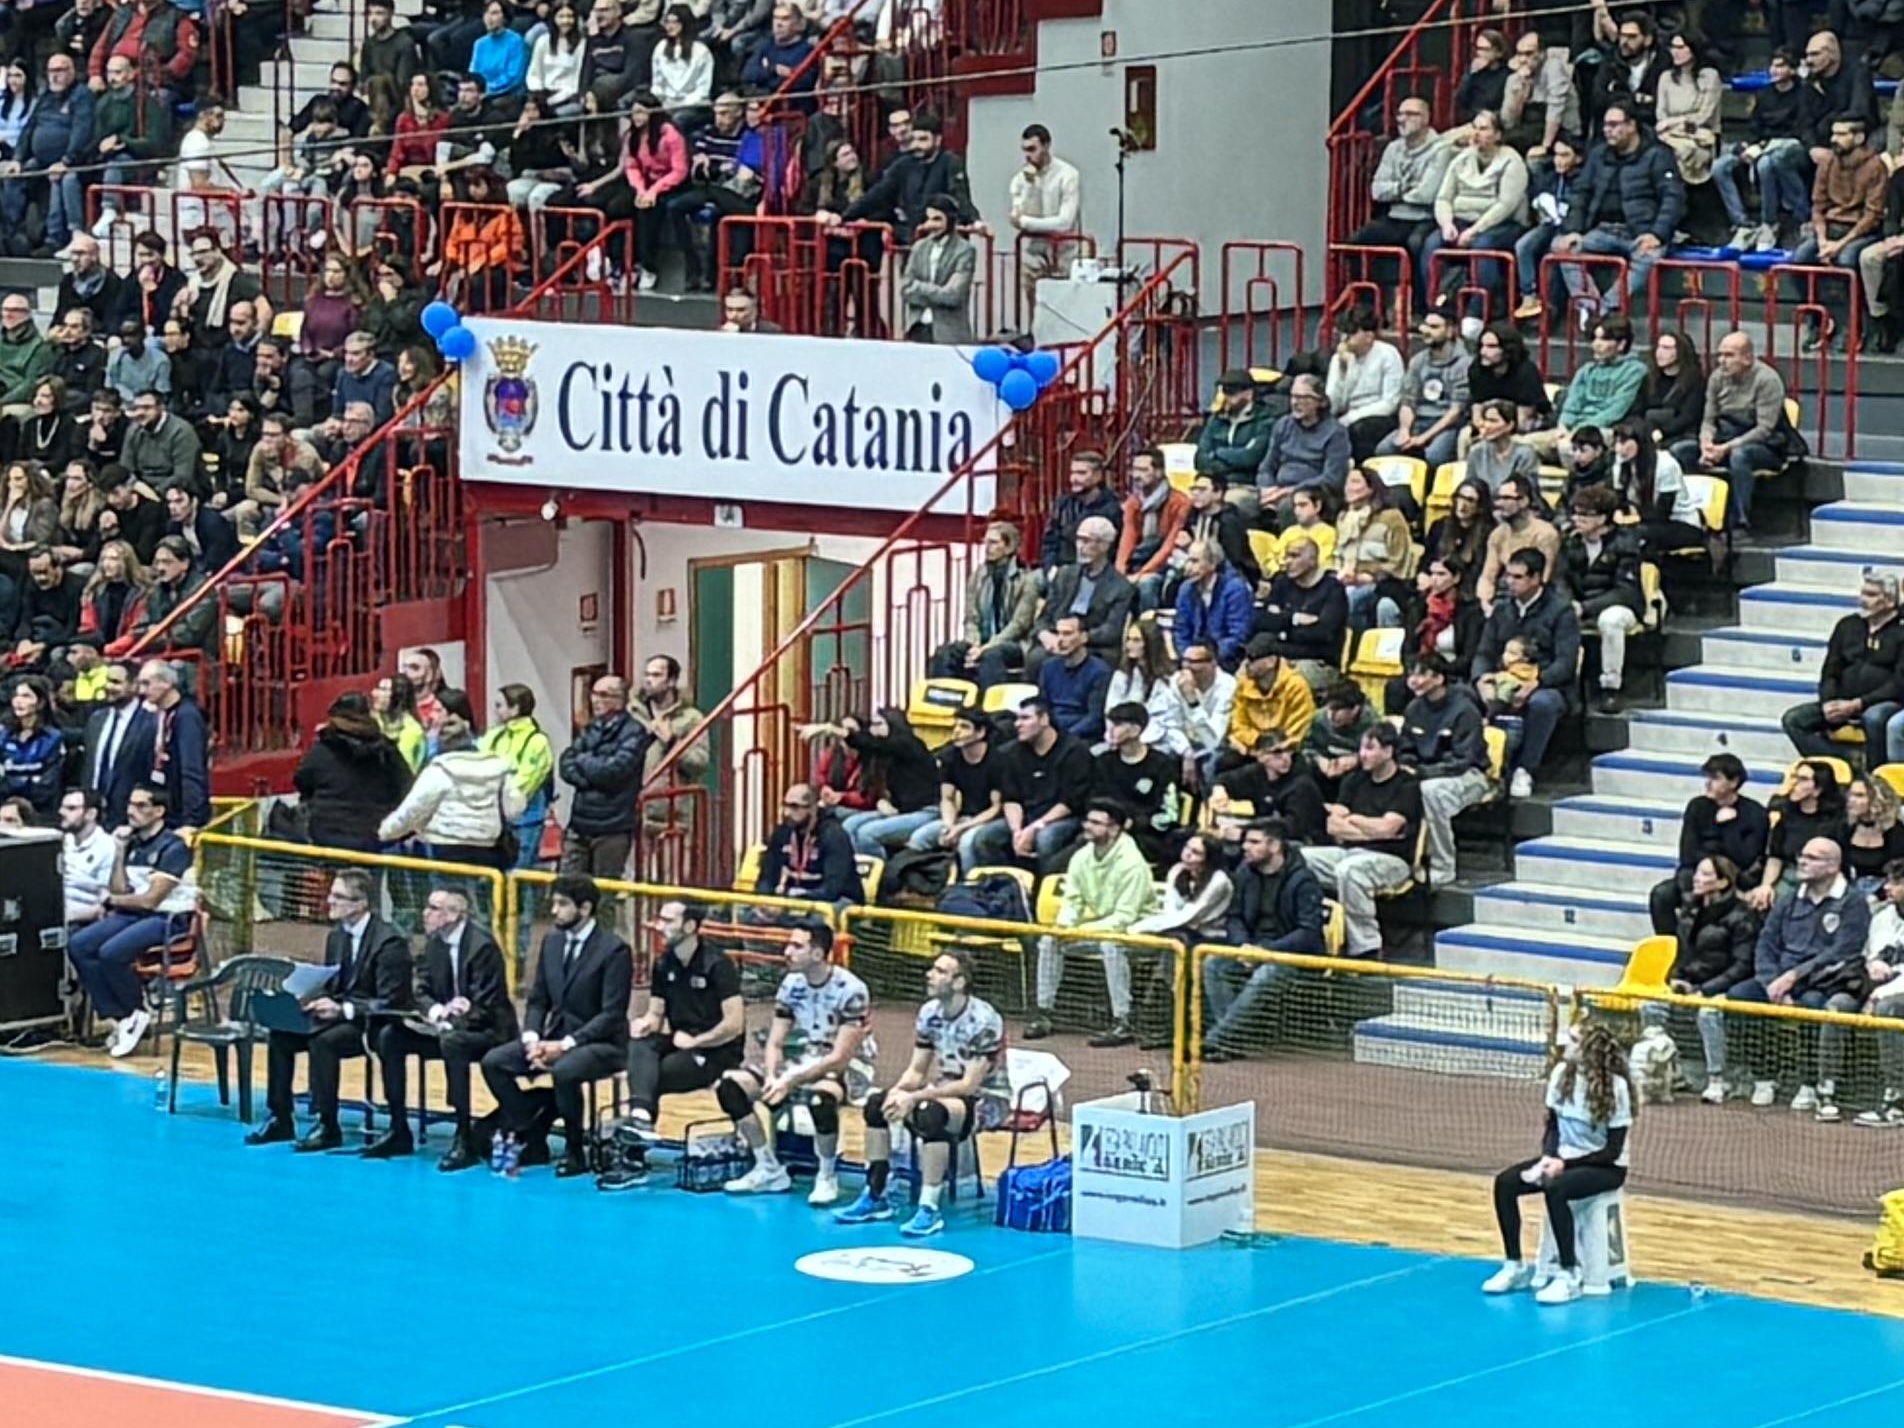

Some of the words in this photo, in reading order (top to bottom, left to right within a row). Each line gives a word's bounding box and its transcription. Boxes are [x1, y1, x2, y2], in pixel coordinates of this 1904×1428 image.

[558, 360, 683, 456] Città
[702, 370, 750, 461] di
[768, 373, 972, 474] Catania
